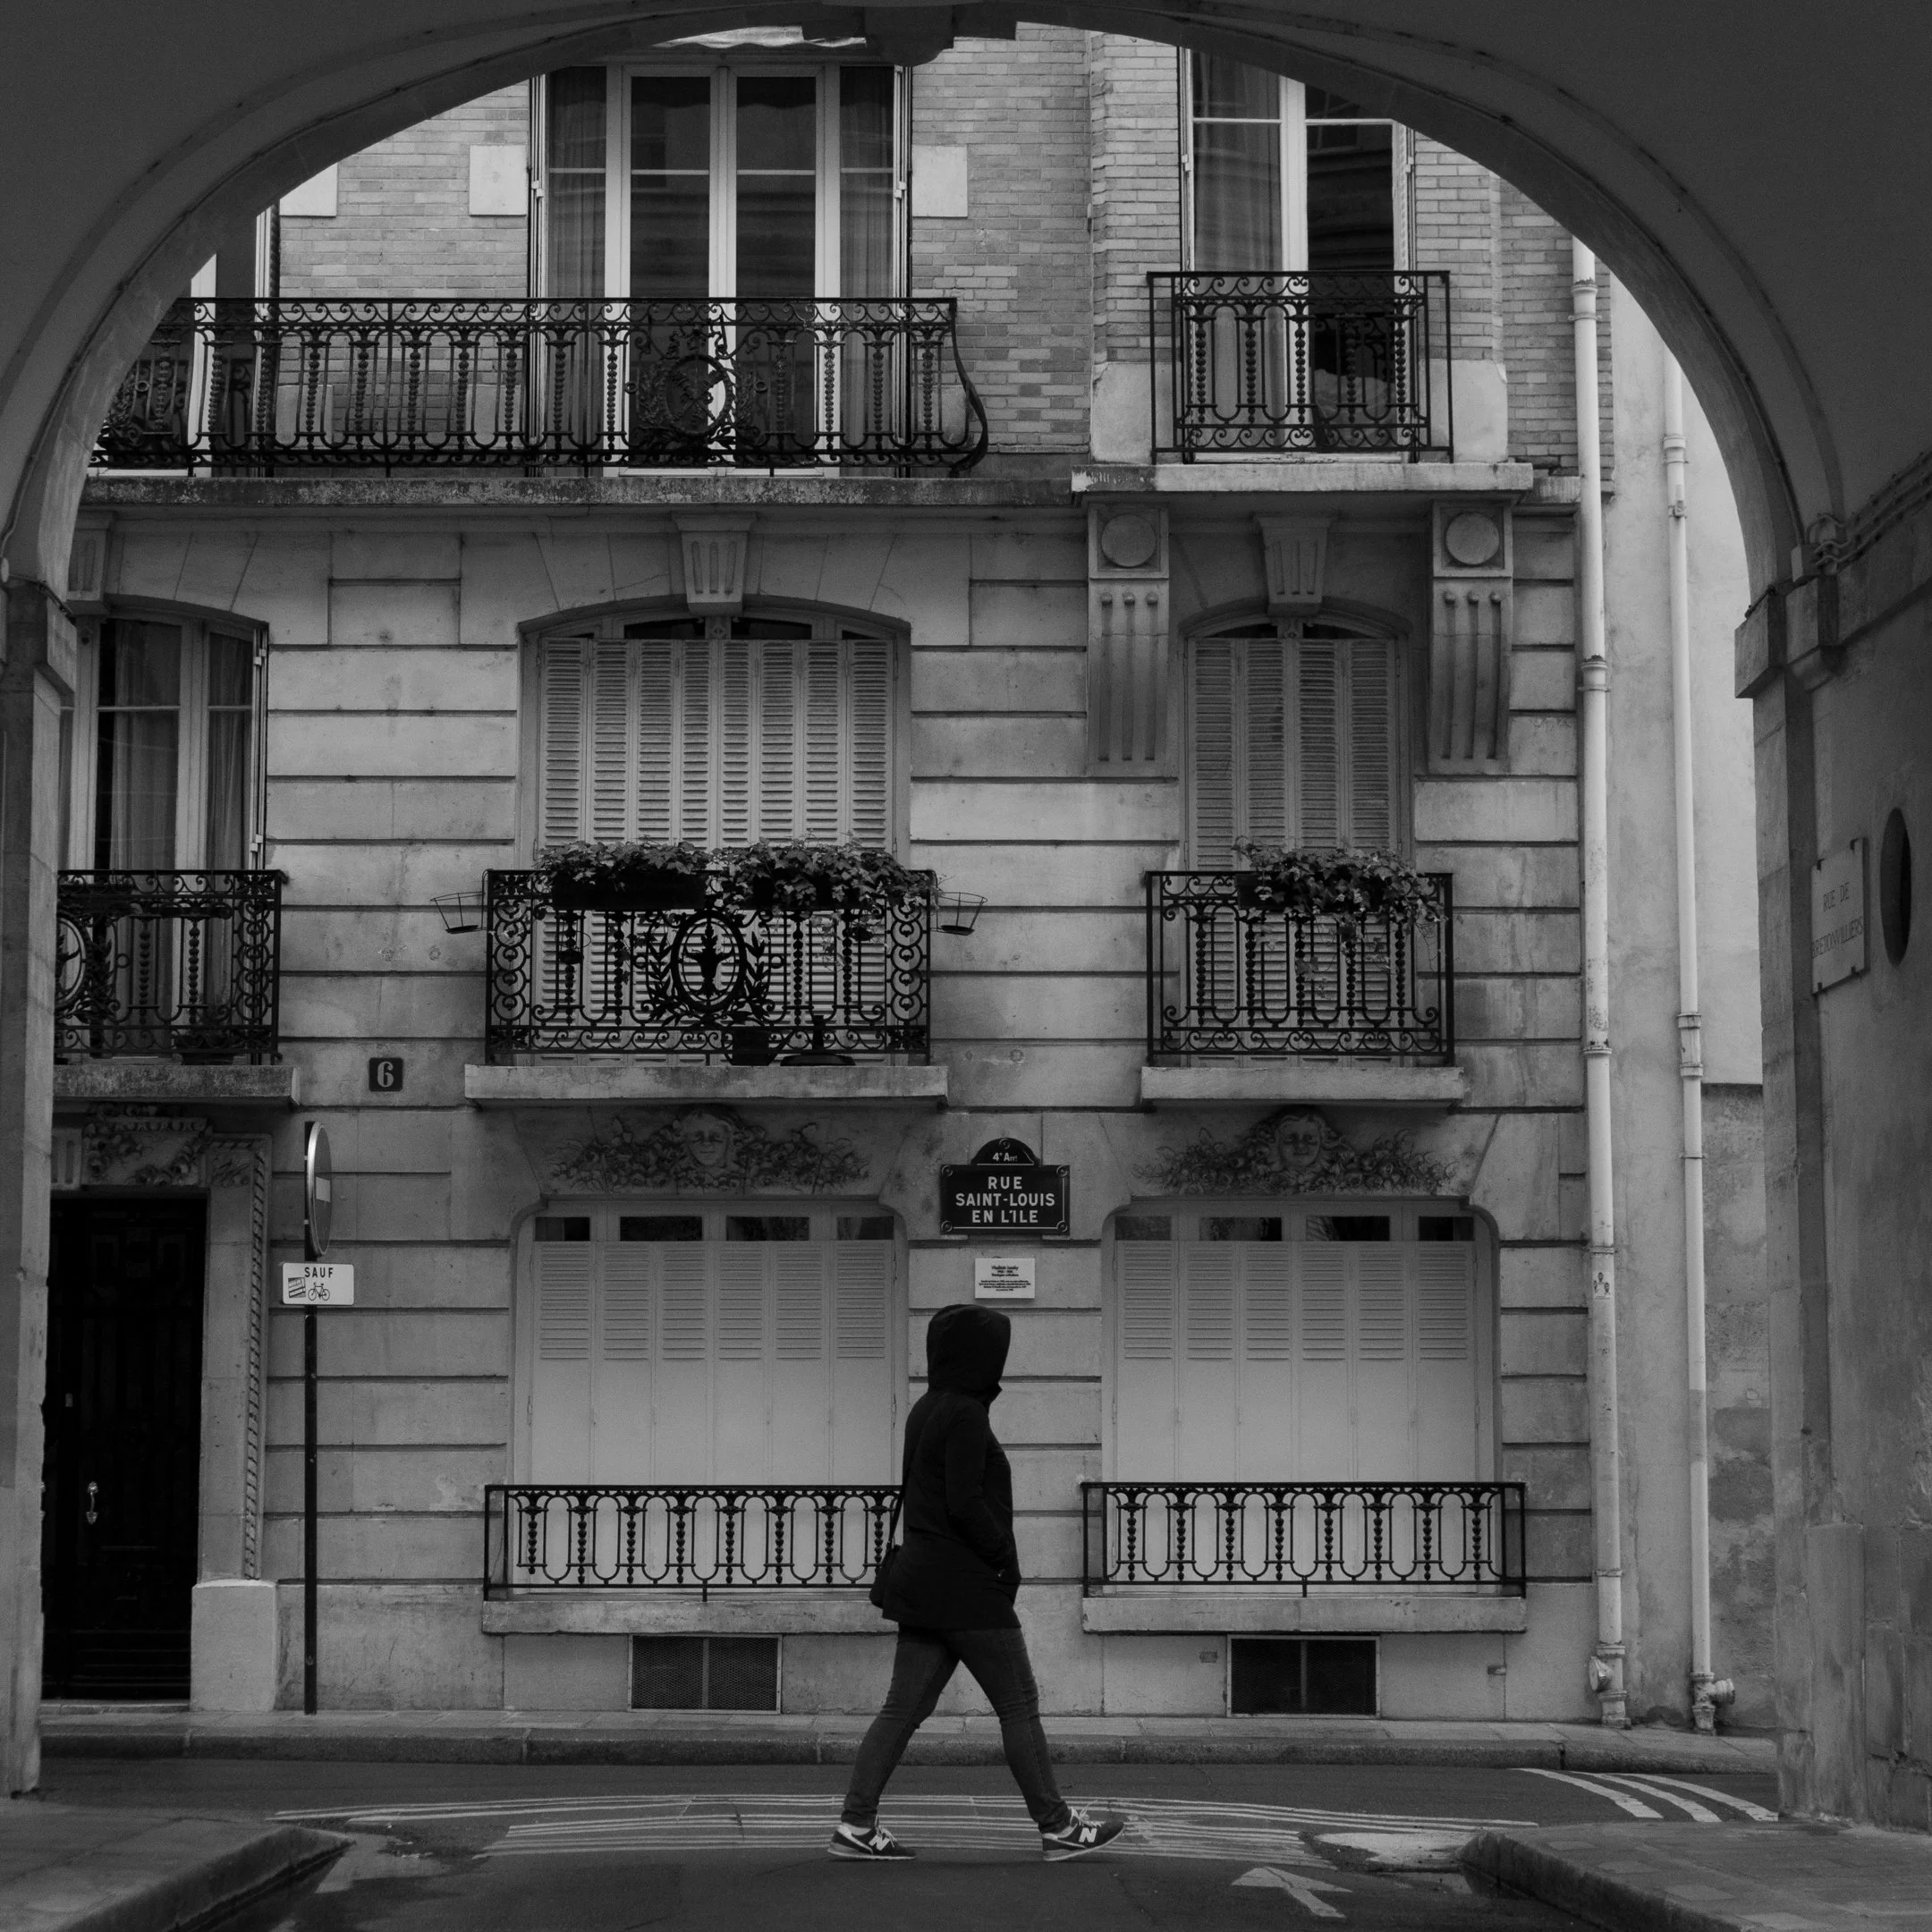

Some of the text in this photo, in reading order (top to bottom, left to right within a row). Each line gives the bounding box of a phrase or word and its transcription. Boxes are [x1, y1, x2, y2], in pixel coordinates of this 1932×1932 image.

[377, 1061, 394, 1088] 6
[987, 1176, 1022, 1190] RUE
[955, 1192, 1055, 1207] SAINT-LOUIS
[972, 1209, 993, 1224] EN
[304, 1267, 334, 1278] SAUF
[1079, 1827, 1097, 1843] N
